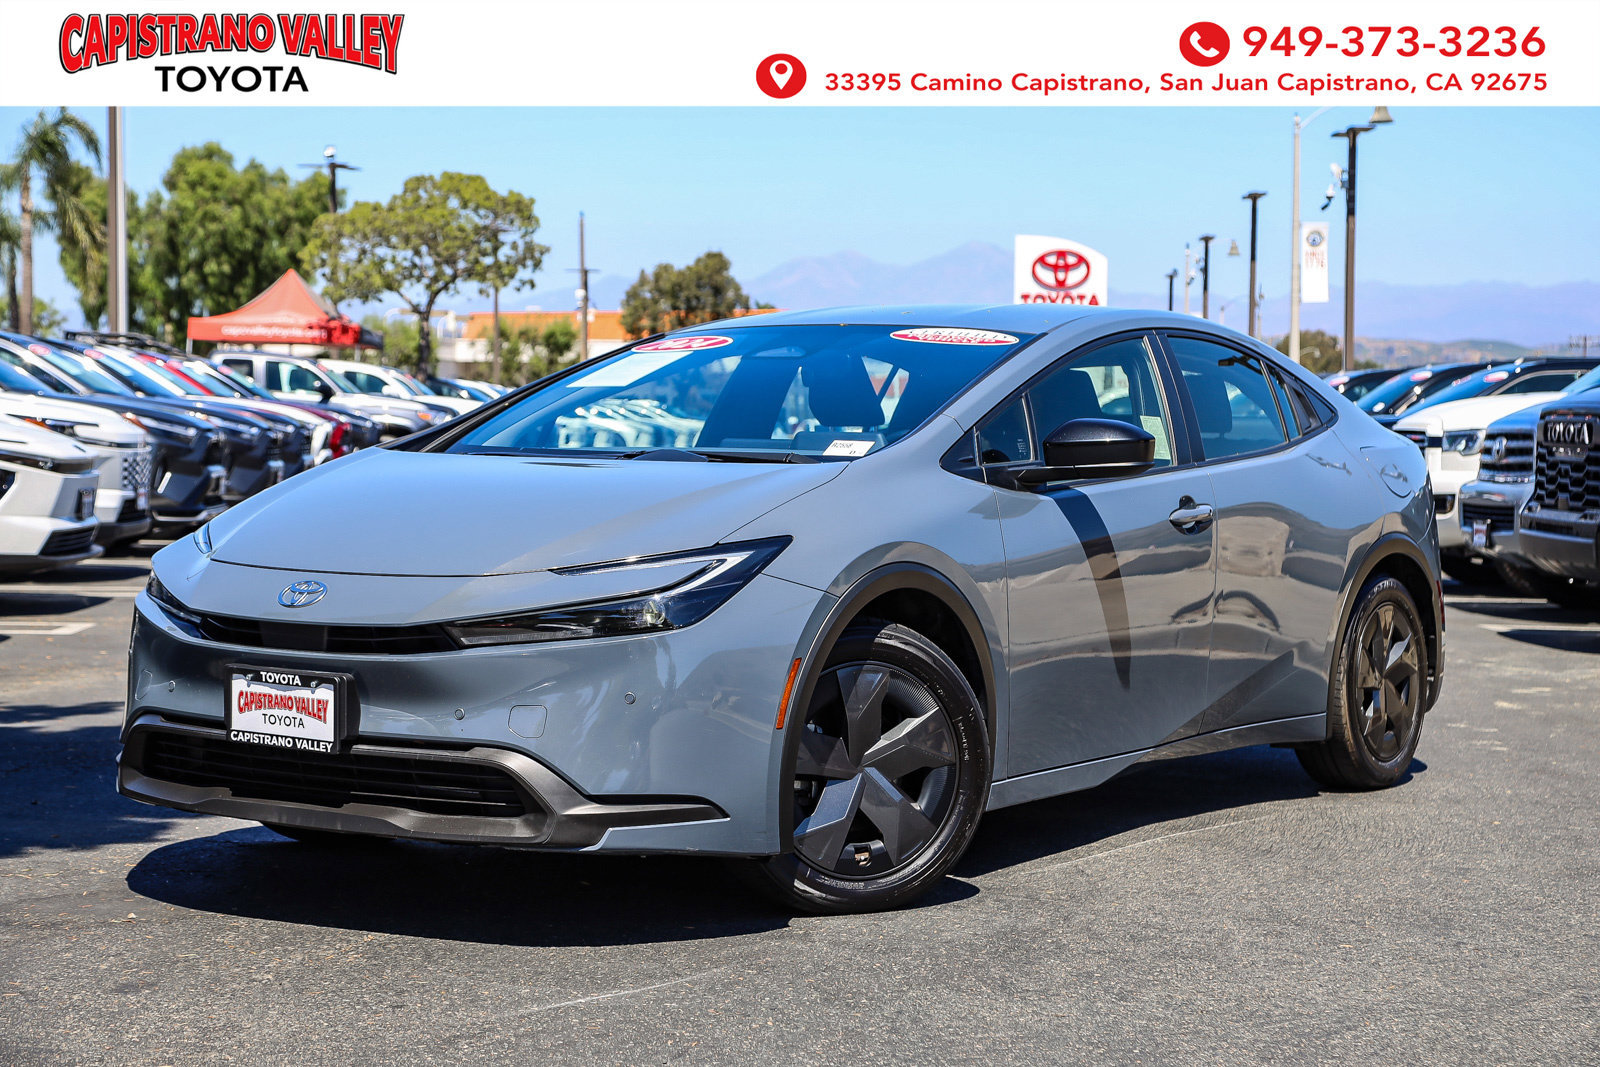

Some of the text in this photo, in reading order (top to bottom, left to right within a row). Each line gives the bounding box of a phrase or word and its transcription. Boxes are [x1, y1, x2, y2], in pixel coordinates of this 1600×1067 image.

[260, 671, 302, 687] TOYOTA
[238, 690, 329, 725] CAPISTRANO VALLEY
[262, 713, 305, 729] TOYOTA
[230, 730, 334, 753] CAPISTRANO VALLEY
